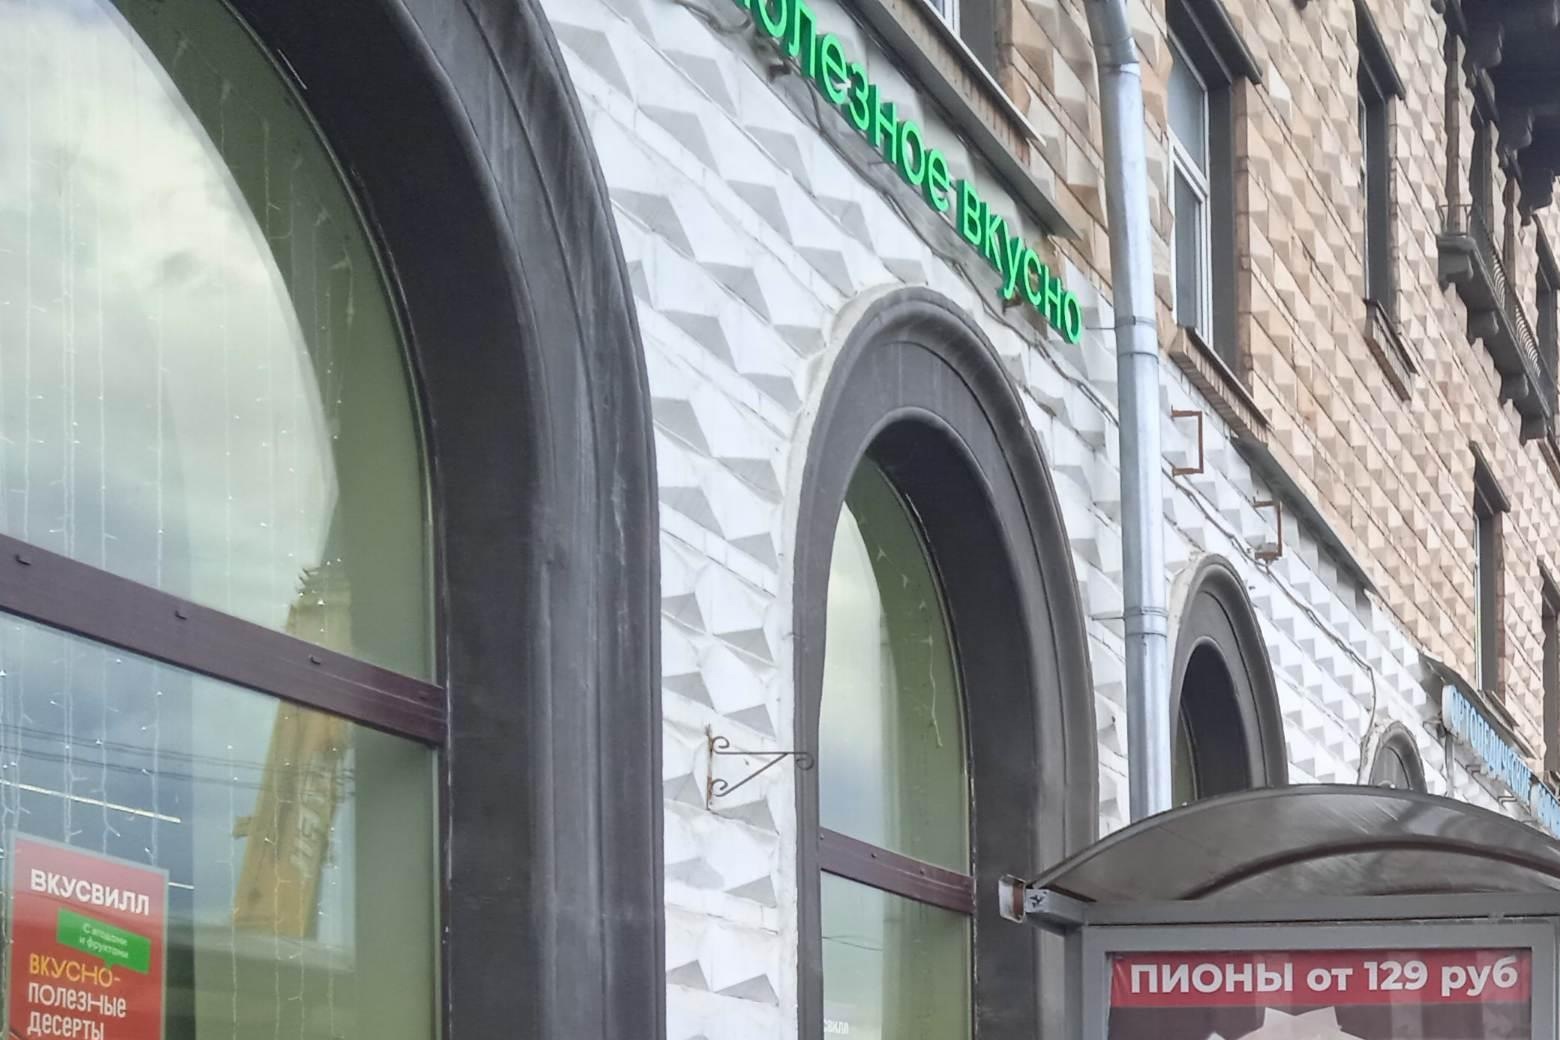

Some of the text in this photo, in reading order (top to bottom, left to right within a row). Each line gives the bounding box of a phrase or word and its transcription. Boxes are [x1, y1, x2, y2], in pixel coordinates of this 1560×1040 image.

[744, 0, 1082, 344] олезное вкусно
[31, 868, 149, 916] ВКУСВИЛЛ
[1130, 955, 1518, 997] ПИОНЫ от 129 руб
